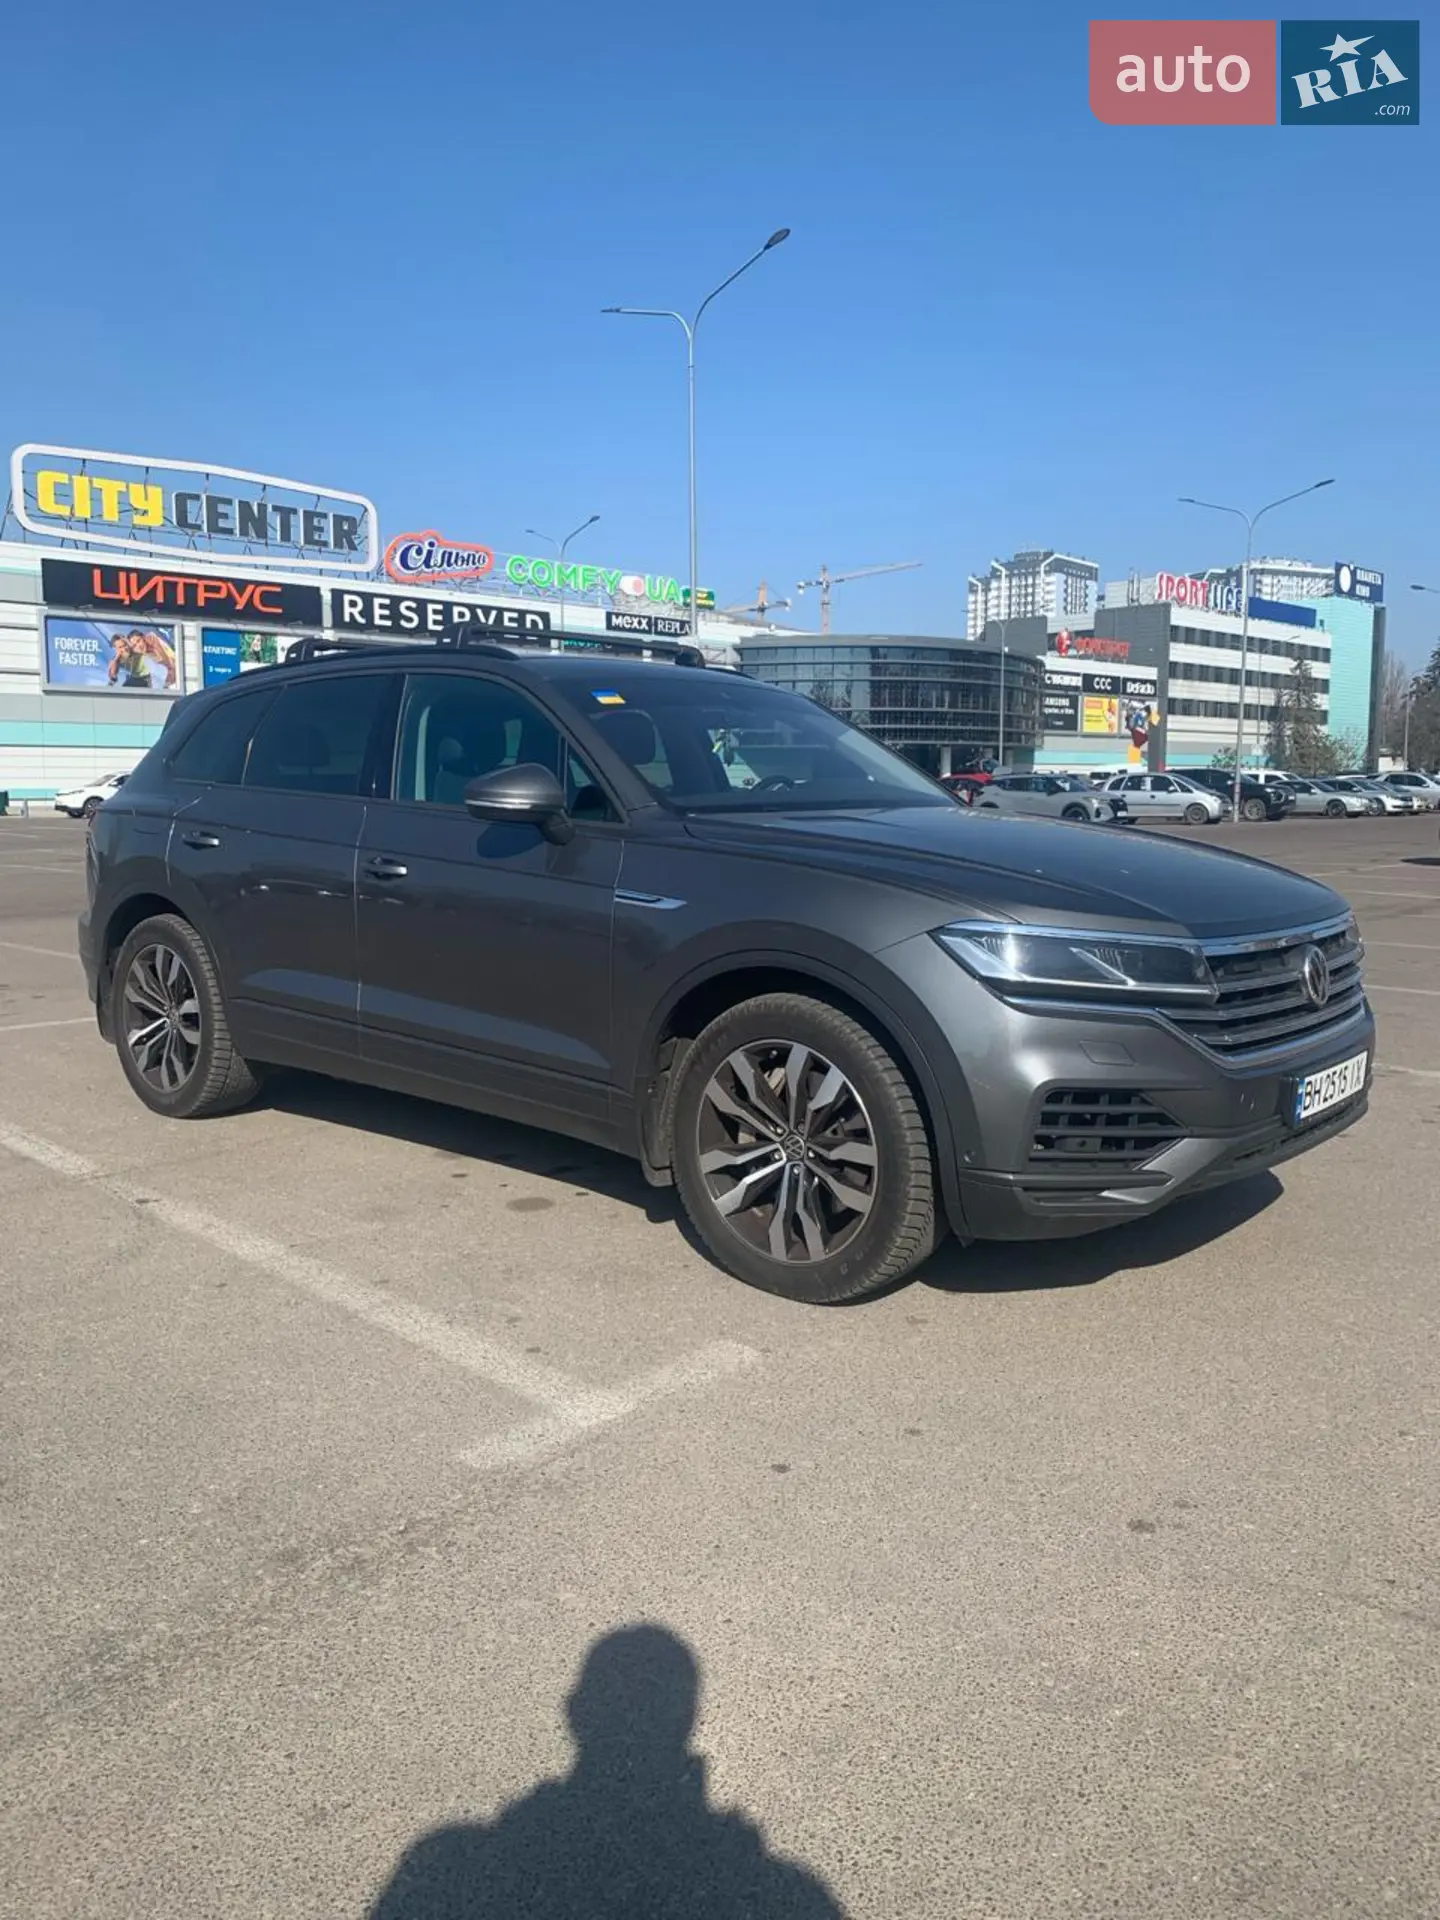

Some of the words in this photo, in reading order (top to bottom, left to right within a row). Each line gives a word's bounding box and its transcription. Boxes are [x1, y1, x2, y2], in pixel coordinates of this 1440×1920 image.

[36, 470, 164, 527] CITY
[172, 491, 358, 551] CENTER
[396, 538, 489, 574] Сільпо
[92, 568, 283, 614] ЦИТРУС
[506, 554, 622, 596] COMFY
[1155, 570, 1209, 608] SPORT
[54, 637, 103, 653] FOREVER.
[656, 619, 692, 635] REPLA
[58, 651, 99, 667] FASTER.
